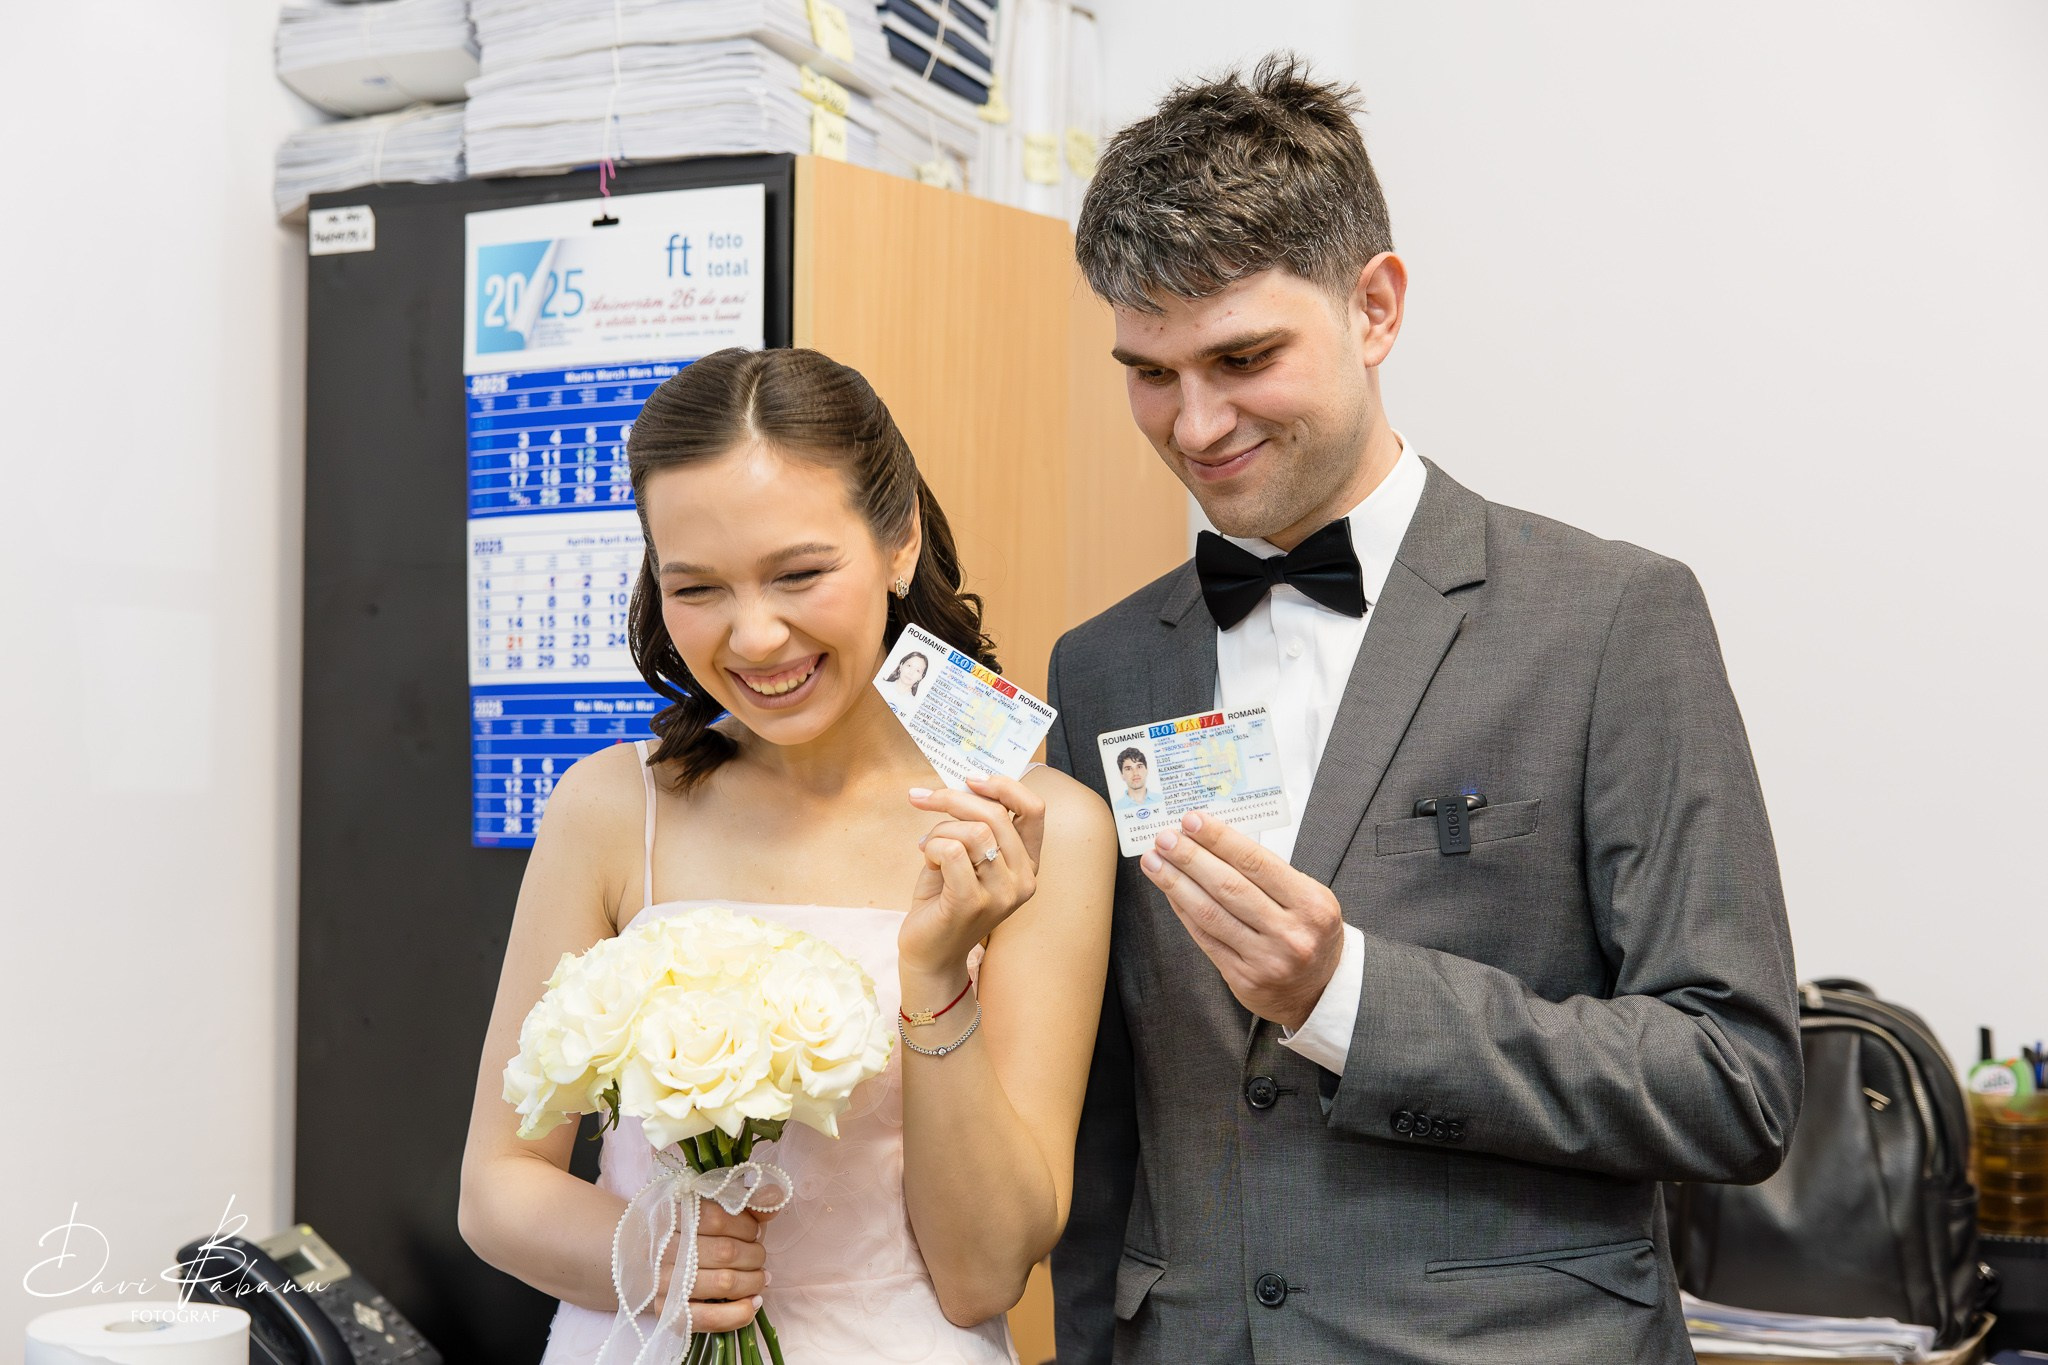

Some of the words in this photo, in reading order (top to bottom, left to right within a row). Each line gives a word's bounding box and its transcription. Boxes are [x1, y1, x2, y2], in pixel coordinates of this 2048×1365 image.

[708, 232, 744, 249] foto
[666, 233, 692, 278] ft
[707, 259, 749, 278] total
[484, 268, 585, 328] 2025
[669, 287, 696, 311] 26
[549, 429, 562, 446] 4
[508, 451, 529, 469] 10
[540, 449, 561, 467] 11
[508, 471, 529, 489] 17
[549, 576, 556, 588] 1
[583, 574, 592, 587] 2
[618, 572, 628, 585] 3
[582, 594, 592, 607] 9
[608, 592, 627, 606] 10
[539, 616, 556, 629] 15
[573, 615, 591, 627] 16
[608, 613, 627, 625] 17
[506, 636, 523, 650] 21
[537, 635, 556, 648] 22
[572, 633, 590, 647] 23
[608, 632, 626, 646] 24
[571, 653, 590, 667] 30
[907, 627, 947, 654] ROUMANIE
[1018, 694, 1053, 718] ROMANIA
[1101, 730, 1145, 745] ROUMANIE
[1227, 706, 1266, 720] ROMANIA
